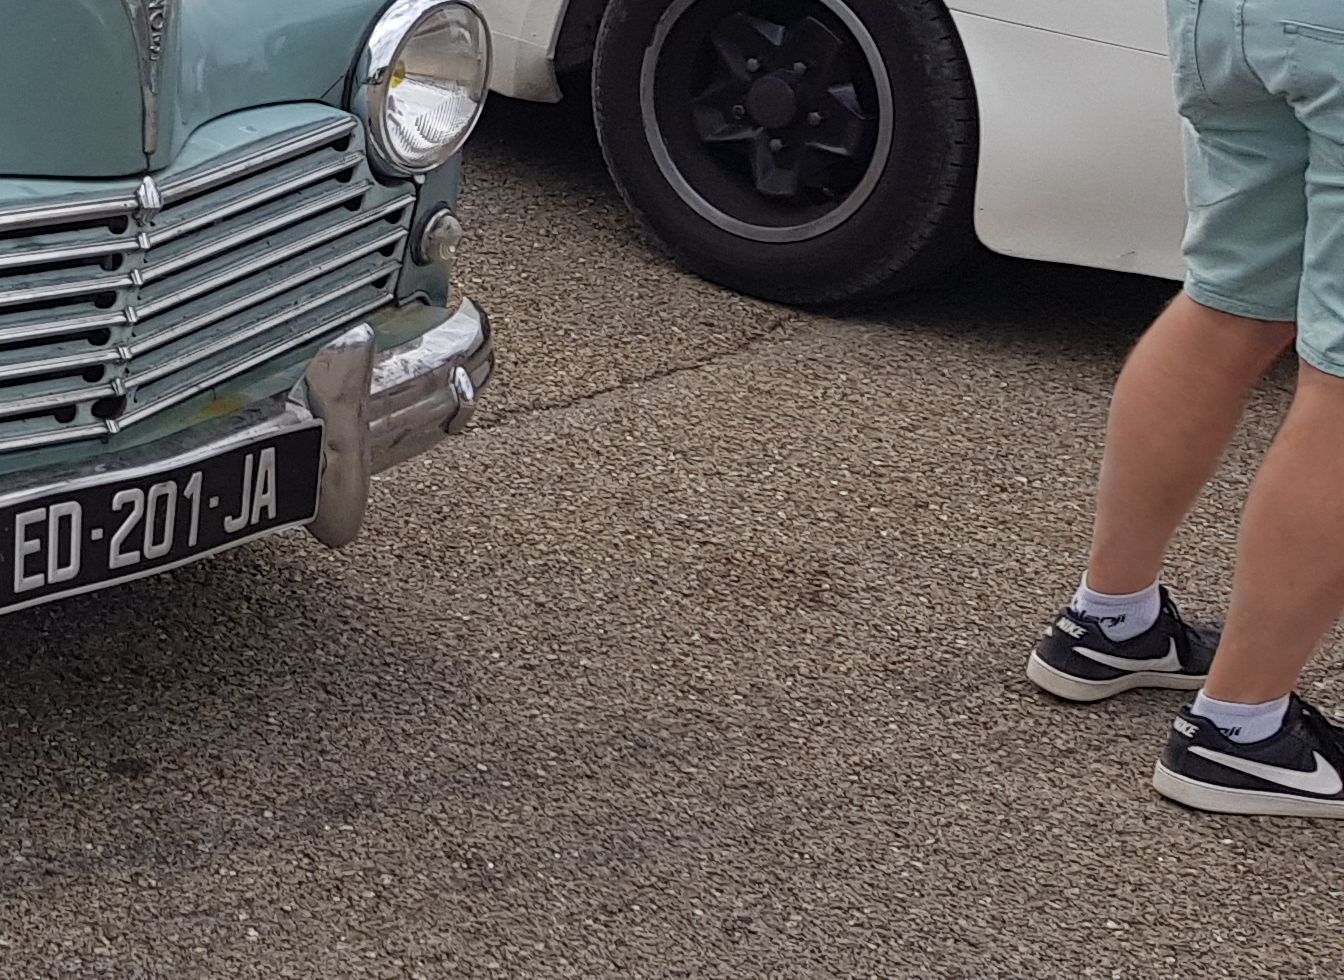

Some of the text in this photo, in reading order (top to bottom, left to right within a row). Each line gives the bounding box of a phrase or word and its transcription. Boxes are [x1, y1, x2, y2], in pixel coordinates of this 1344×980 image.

[14, 447, 277, 593] ED-201-JA
[1056, 617, 1088, 640] NIKE
[1173, 716, 1200, 739] NIKE
